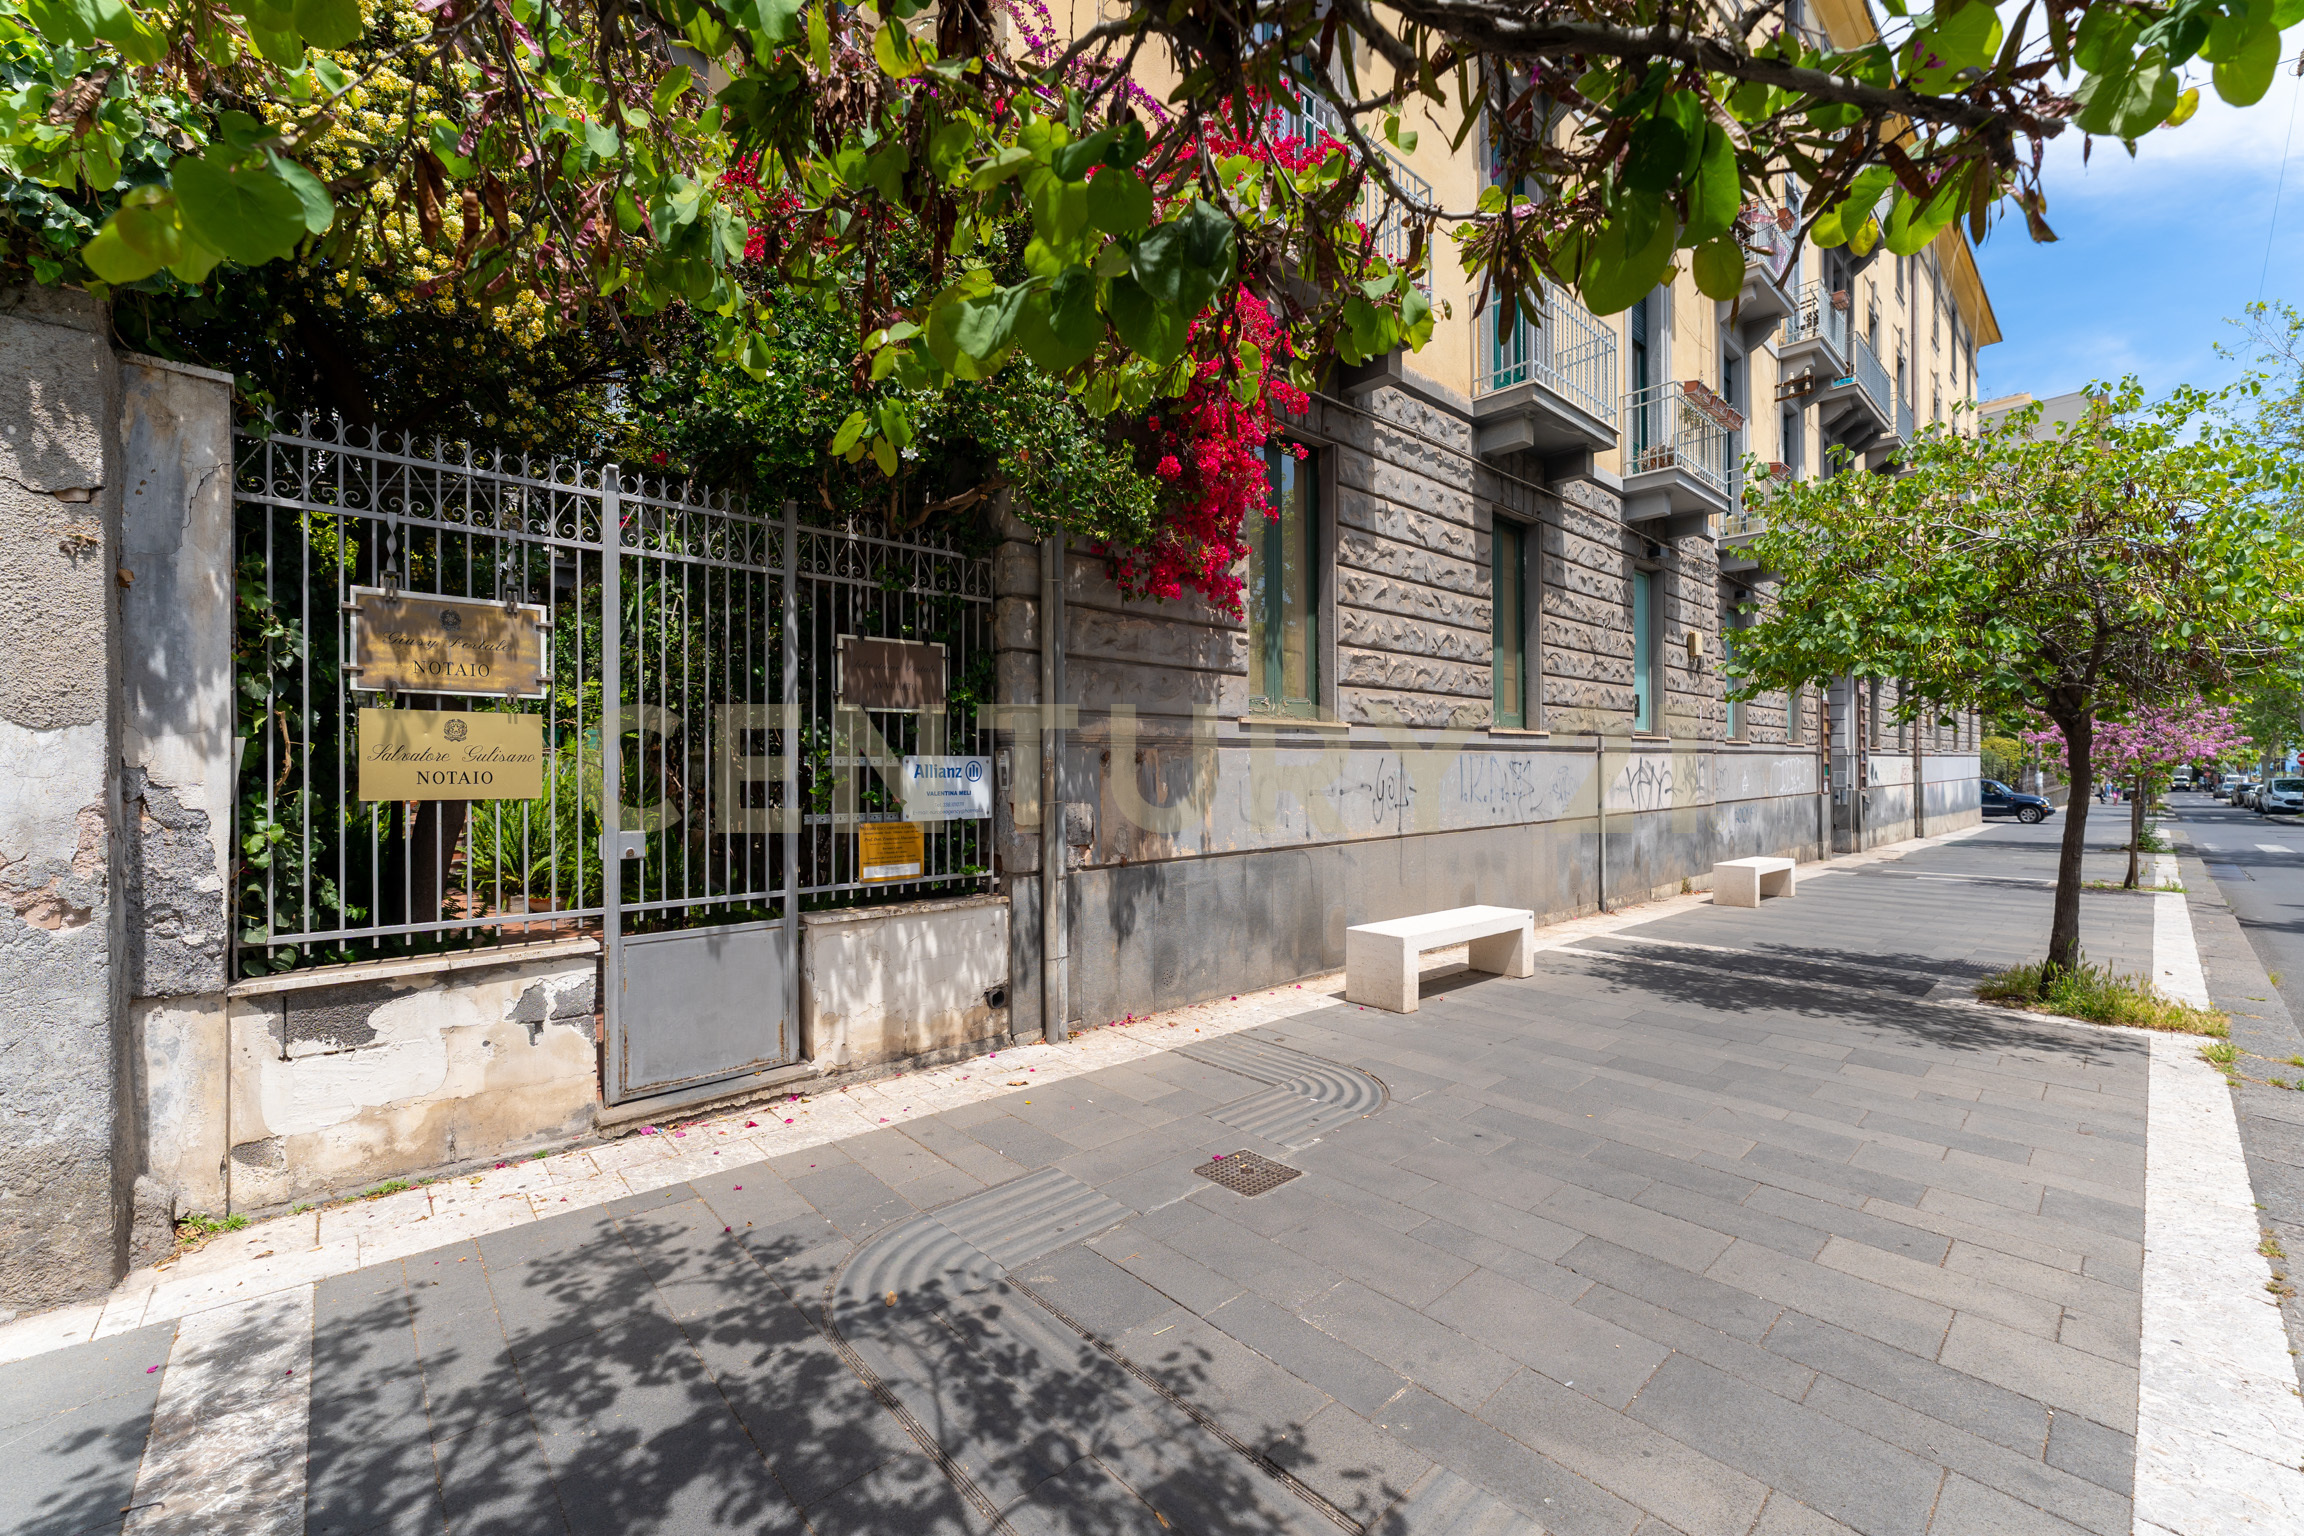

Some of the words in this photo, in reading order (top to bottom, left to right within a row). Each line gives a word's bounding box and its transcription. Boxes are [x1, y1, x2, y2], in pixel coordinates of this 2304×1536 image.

[382, 631, 438, 650] Giusy
[413, 660, 490, 677] NOTAIO
[367, 744, 451, 762] Salvatore
[462, 745, 536, 763] Gulisano
[416, 770, 494, 785] NOTAIO
[914, 764, 962, 778] Allianz
